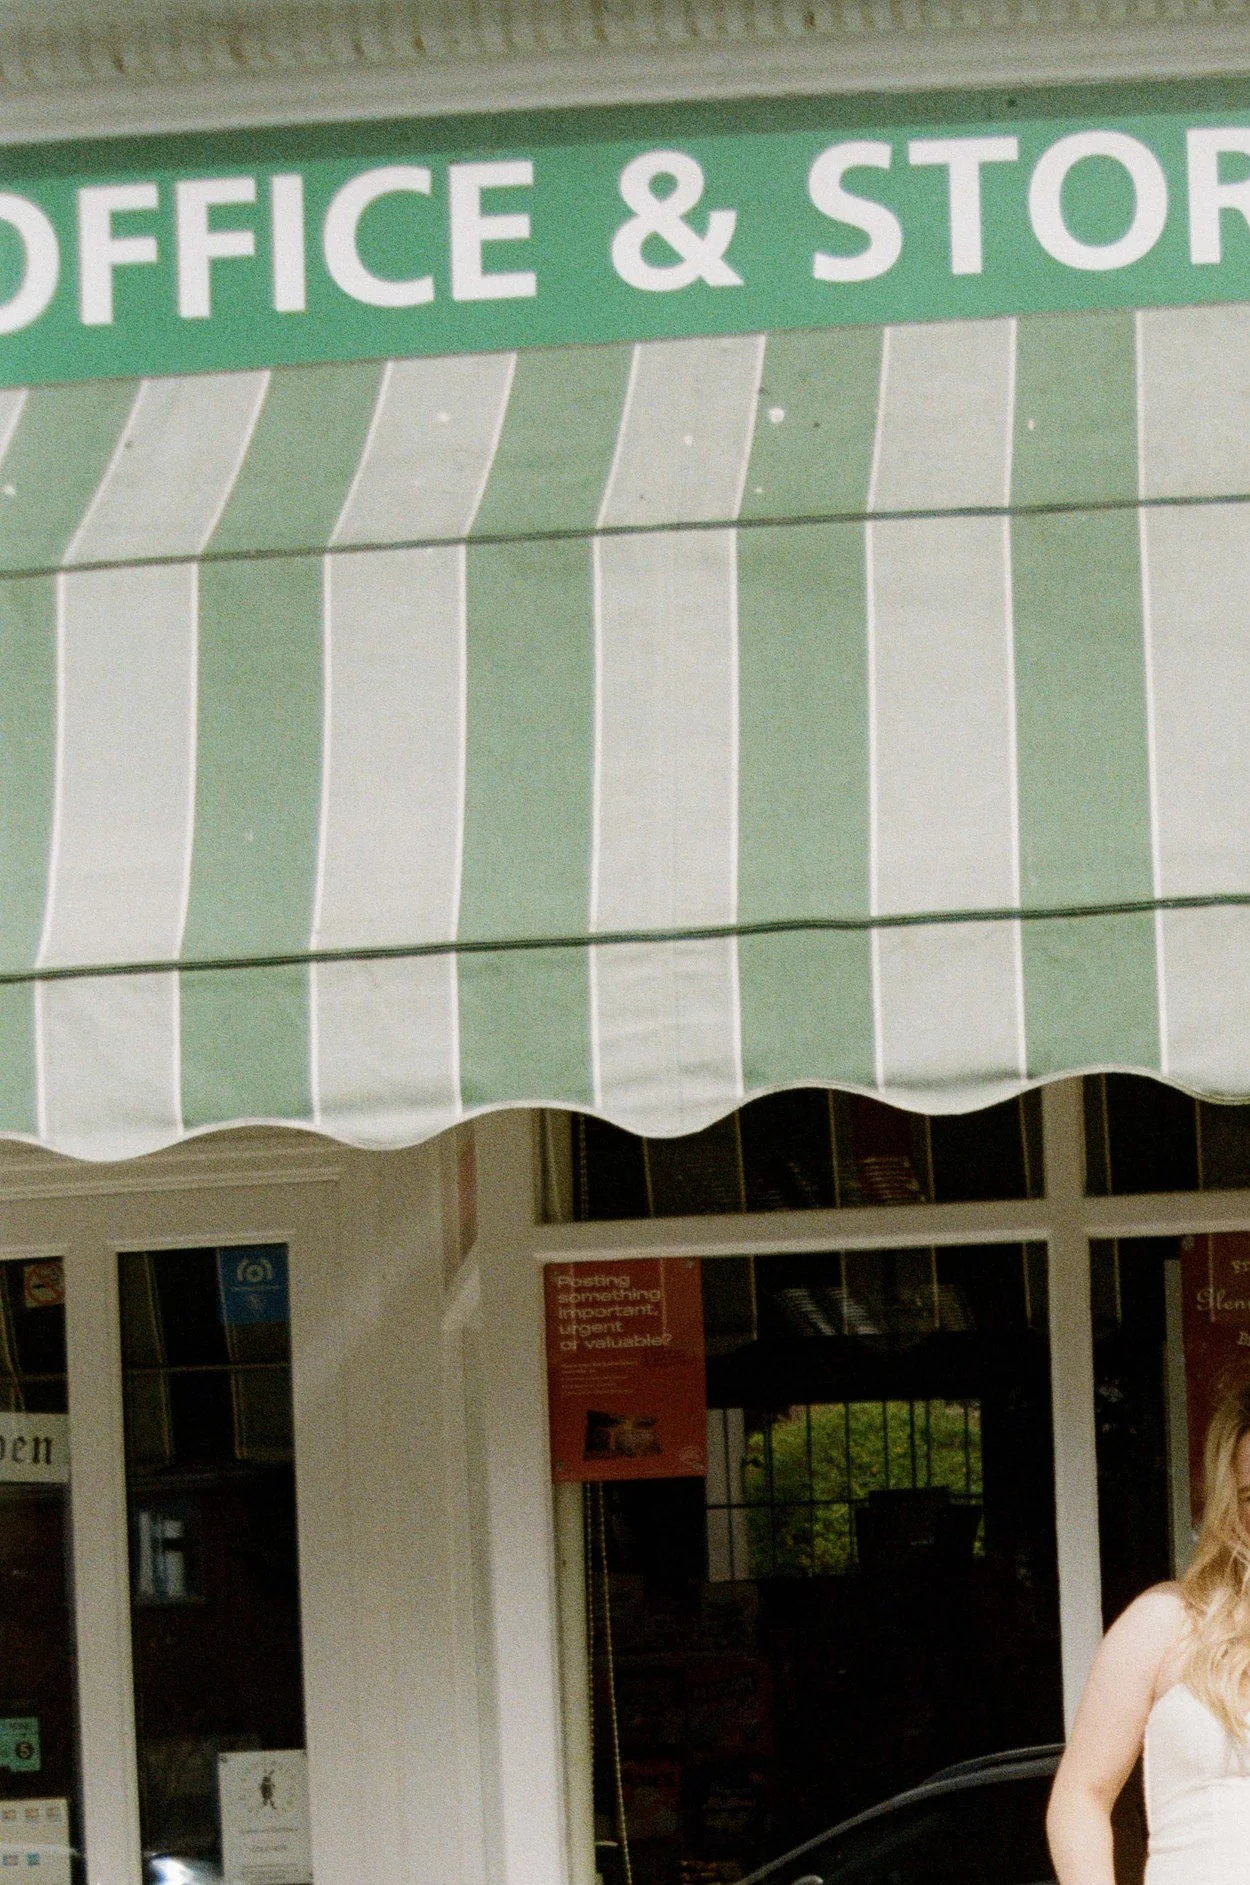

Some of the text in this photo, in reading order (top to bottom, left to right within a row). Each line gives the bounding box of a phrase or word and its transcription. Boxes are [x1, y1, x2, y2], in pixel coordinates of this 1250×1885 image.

[611, 150, 744, 292] &
[556, 1274, 631, 1288] Posting
[557, 1288, 663, 1304] something
[559, 1320, 624, 1335] urgent
[559, 1333, 673, 1351] or valuable?
